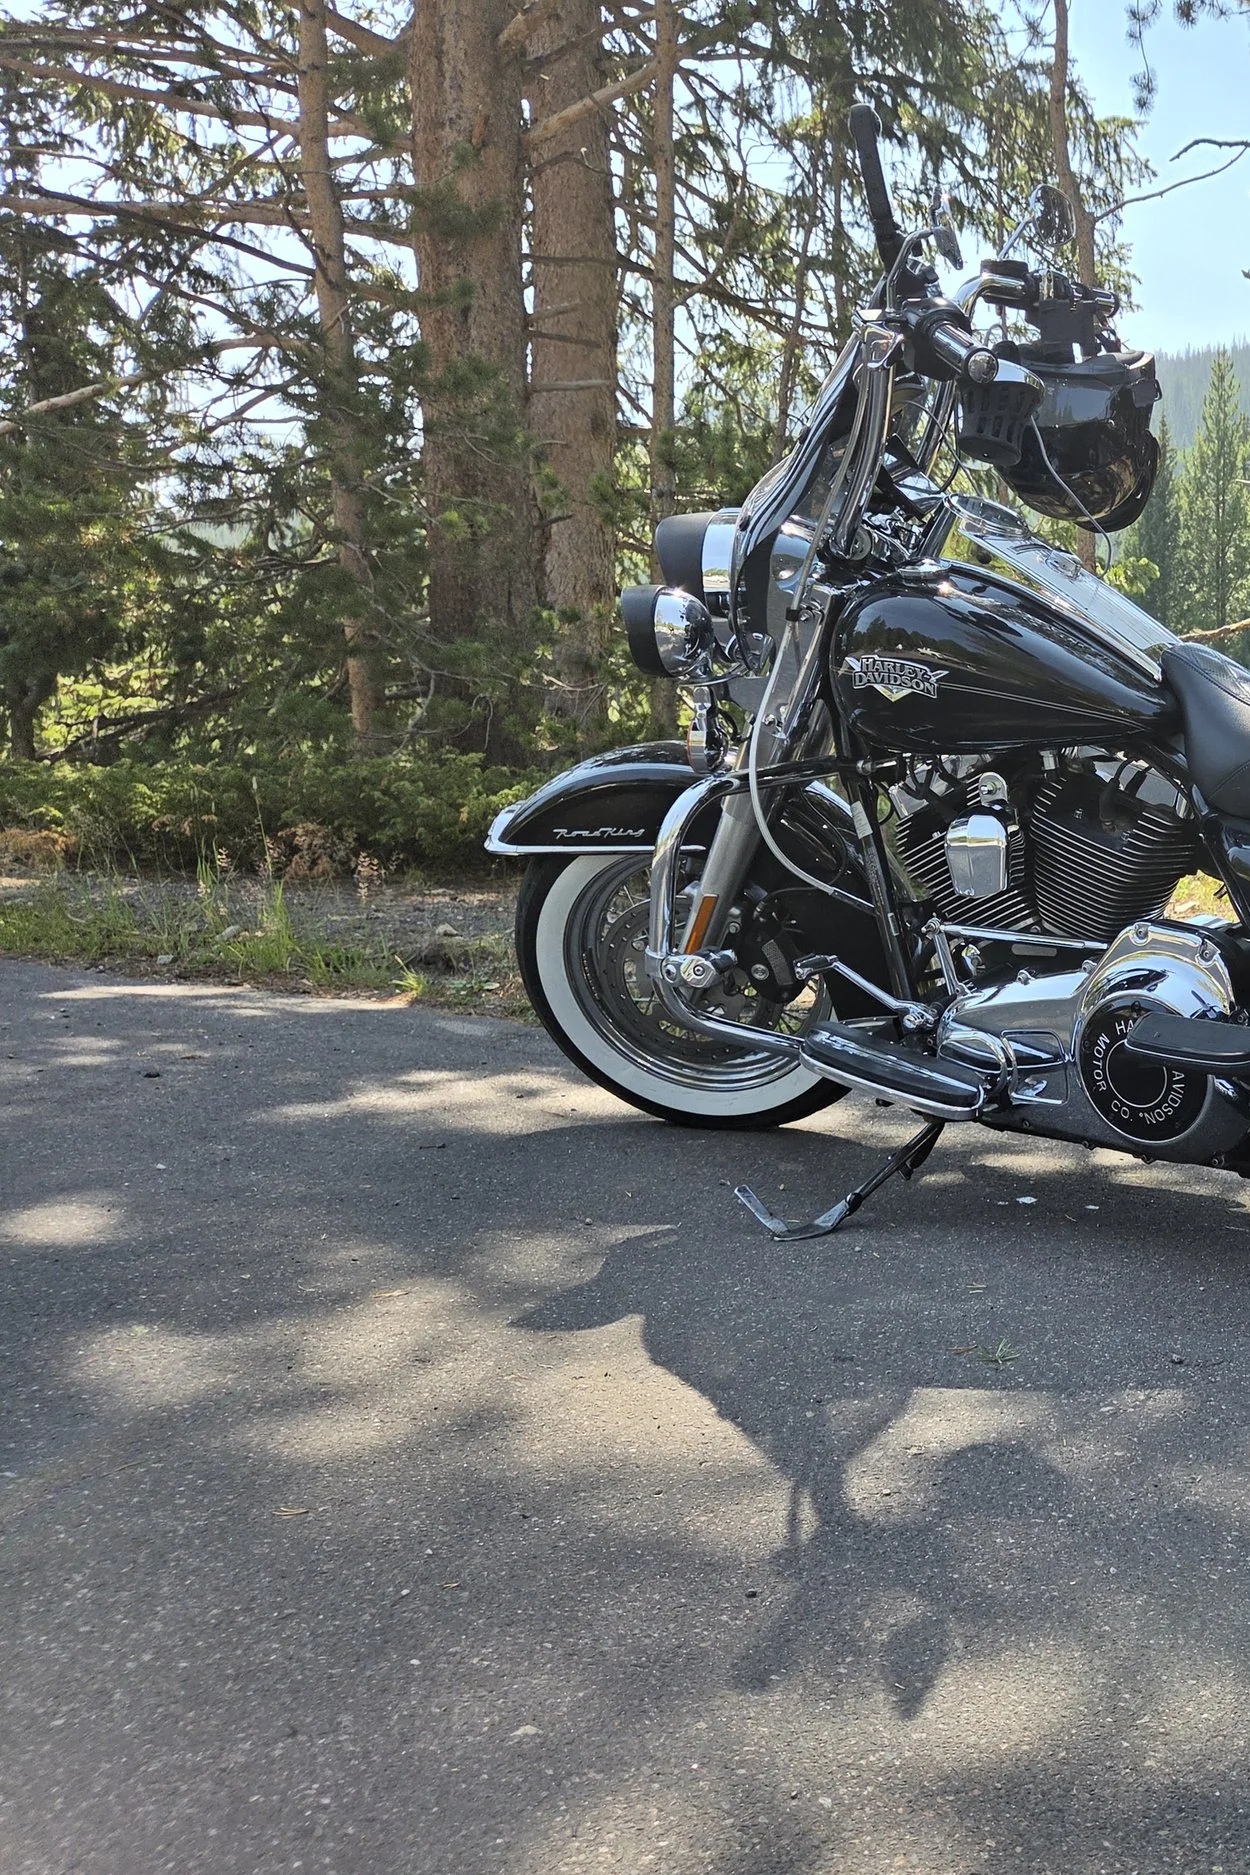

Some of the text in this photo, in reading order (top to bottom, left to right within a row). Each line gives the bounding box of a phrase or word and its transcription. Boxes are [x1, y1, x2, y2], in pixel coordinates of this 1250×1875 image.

[861, 658, 932, 681] HARLEY-
[854, 671, 935, 696] DAVIDSON
[1092, 1032, 1111, 1092] MOTOR
